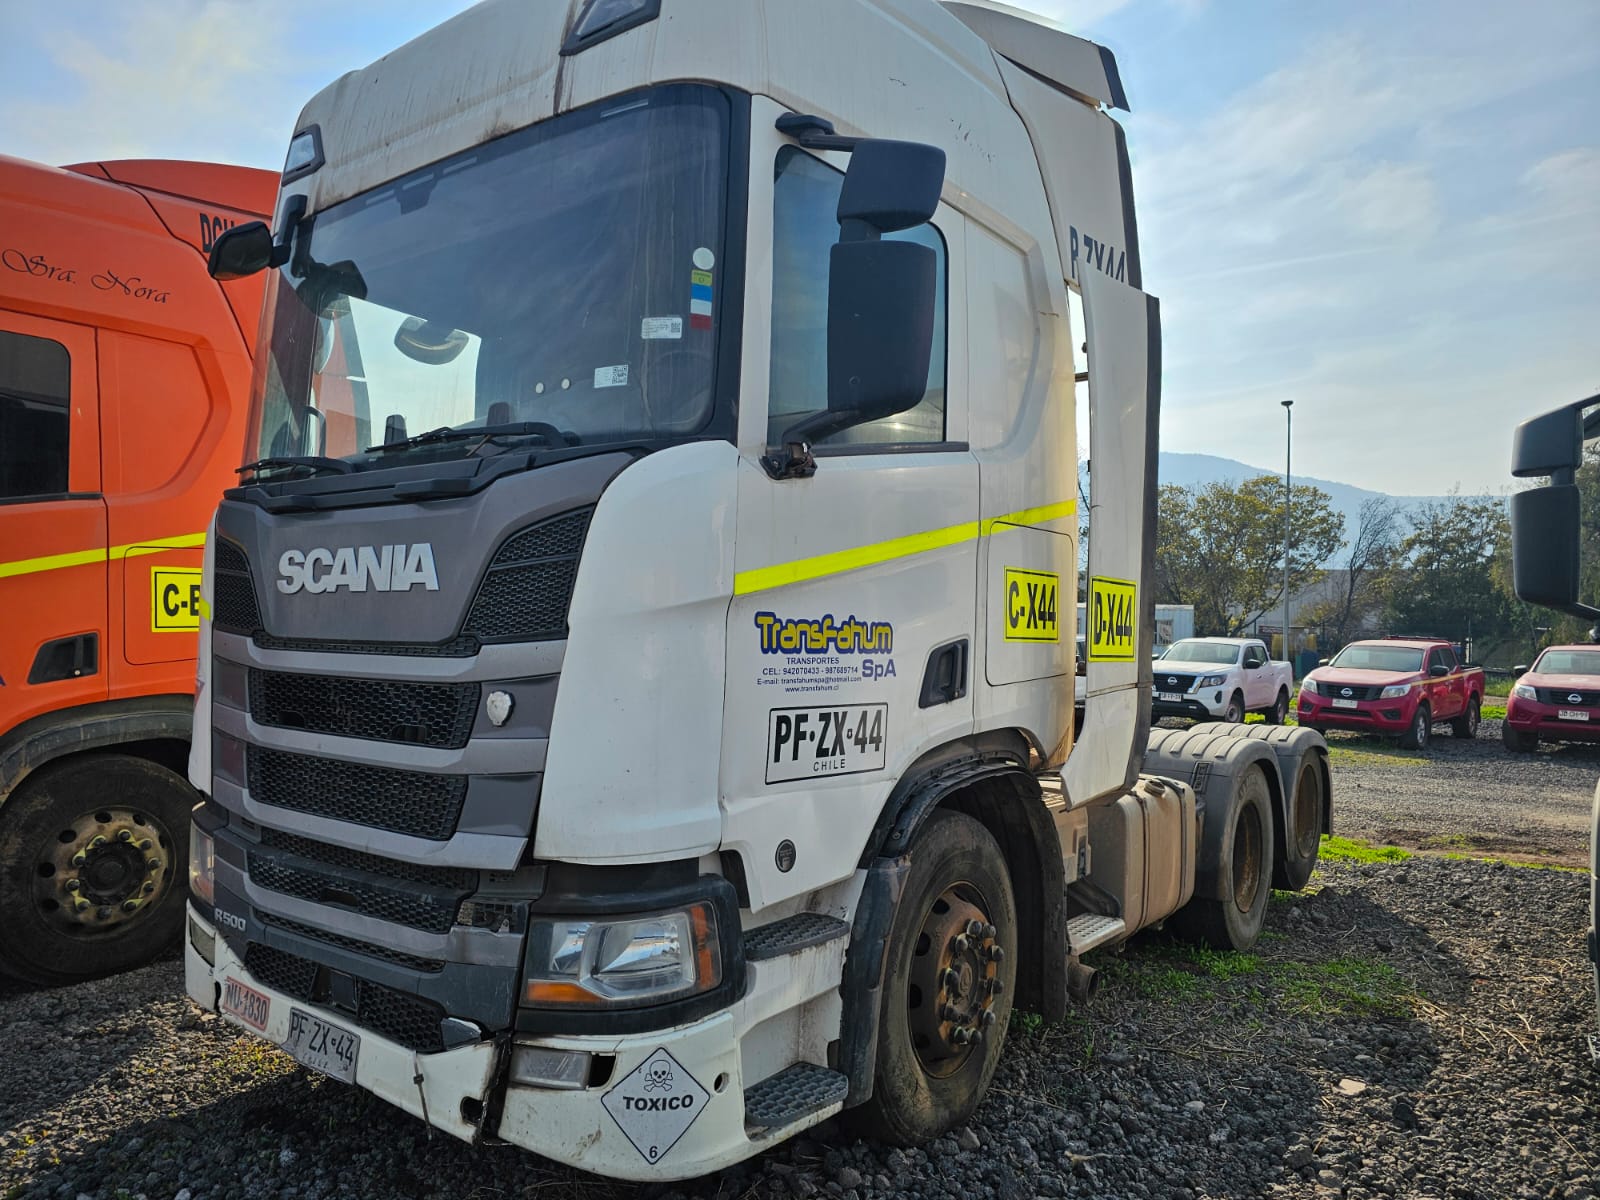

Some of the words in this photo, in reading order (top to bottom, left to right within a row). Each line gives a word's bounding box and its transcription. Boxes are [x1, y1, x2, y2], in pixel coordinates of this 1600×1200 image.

[91, 269, 170, 303] Nora
[277, 543, 439, 594] SCANIA
[1009, 580, 1056, 630] C-X44
[1093, 591, 1132, 646] D-X44
[762, 667, 780, 676] CEL:
[786, 657, 839, 665] TRANSPORTES
[862, 659, 896, 681] SpA
[813, 759, 846, 771] CHILE
[214, 908, 246, 932] R500
[622, 1094, 694, 1112] TOXICO
[649, 1145, 658, 1159] 6
